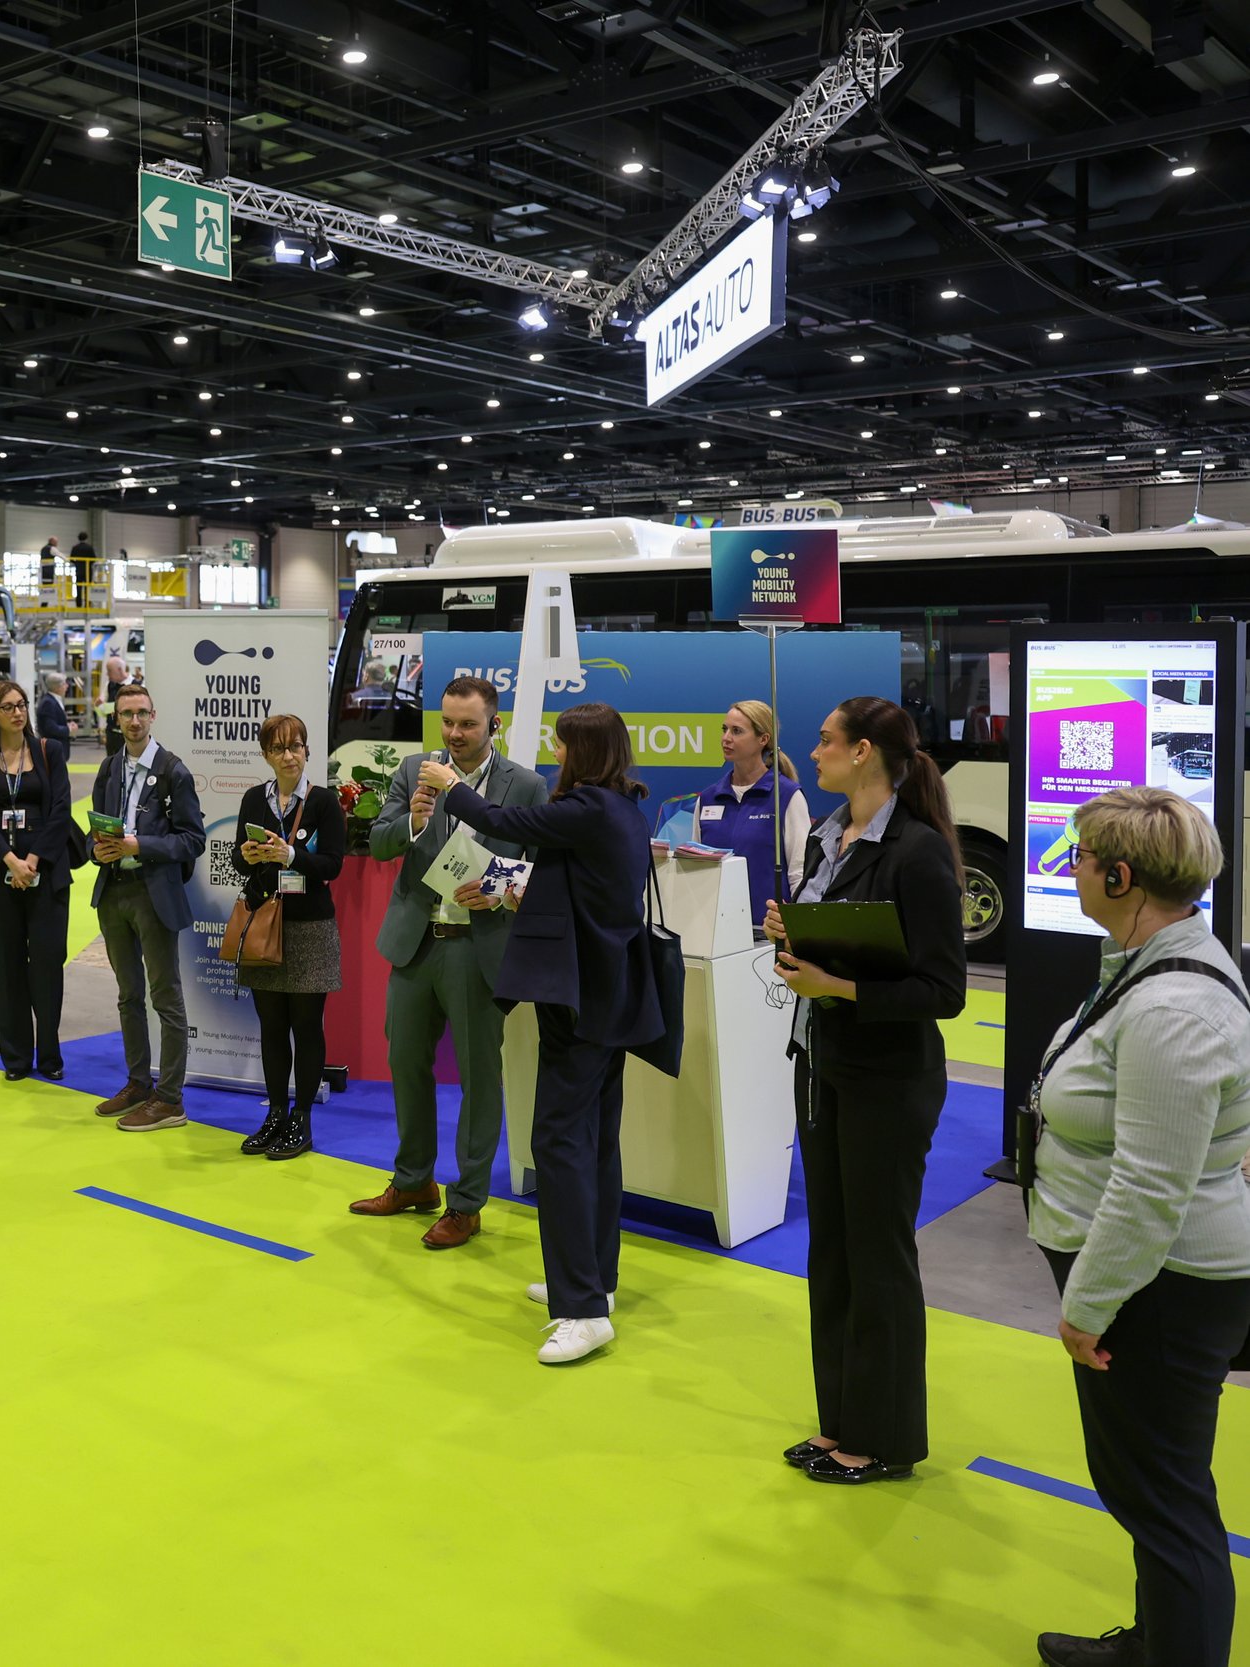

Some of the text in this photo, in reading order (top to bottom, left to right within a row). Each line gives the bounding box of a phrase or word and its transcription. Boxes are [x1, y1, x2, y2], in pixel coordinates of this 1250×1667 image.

[655, 258, 753, 377] ALTAS AUTO
[742, 508, 816, 523] BUS2BUS
[758, 568, 788, 579] YOUNG
[753, 580, 795, 590] MOBILITY
[472, 594, 495, 602] VGM
[752, 592, 797, 602] NETWORK
[374, 639, 406, 649] 27/100
[205, 675, 261, 695] YOUNG
[195, 698, 271, 718] MOBILITY
[193, 721, 261, 741] NETWOR
[192, 749, 227, 757] connecting
[228, 750, 248, 758] young
[214, 757, 252, 765] enthusiasts.
[1042, 783, 1056, 791] FÜR
[1056, 777, 1091, 785] SMARTER
[1092, 779, 1131, 787] BEGLEITER
[196, 976, 225, 987] shaping
[220, 988, 250, 998] moblity
[203, 1031, 219, 1039] Young
[221, 1033, 244, 1042] Mobility
[195, 1047, 261, 1060] young-mobility-networ
